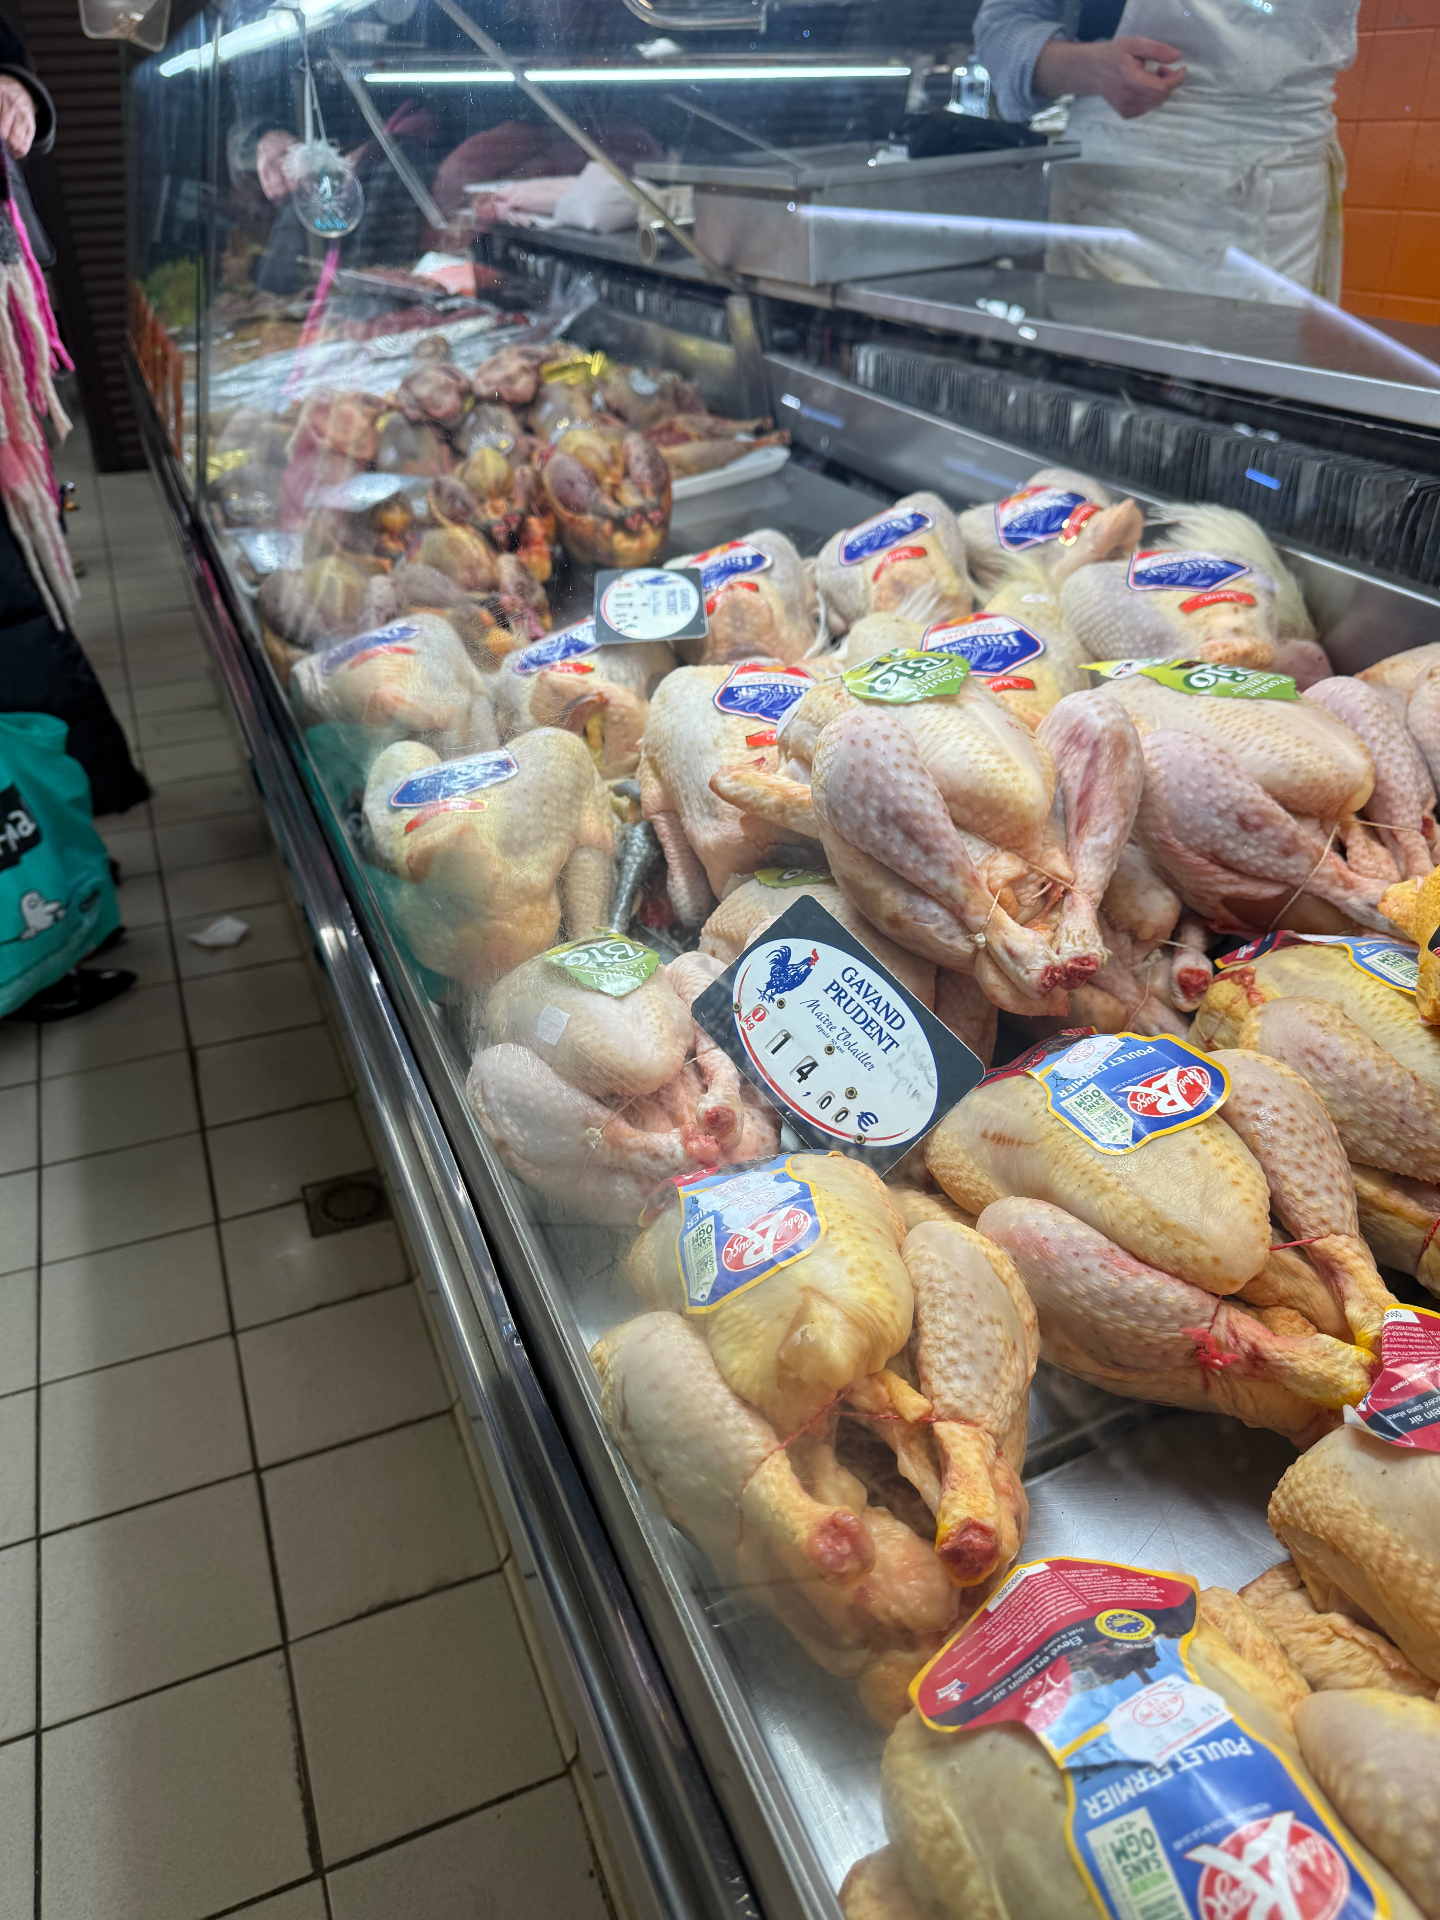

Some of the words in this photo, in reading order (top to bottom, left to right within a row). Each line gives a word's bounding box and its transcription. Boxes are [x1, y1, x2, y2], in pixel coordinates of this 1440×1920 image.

[840, 966, 907, 1031] GAVAND
[743, 1015, 756, 1031] kg
[823, 979, 900, 1055] PRUDENT
[800, 998, 838, 1034] Maître
[840, 1026, 876, 1072] Volailler
[815, 1022, 831, 1041] depuis
[1108, 1045, 1156, 1067] POULET
[1075, 1089, 1100, 1107] OGM
[1083, 1096, 1106, 1112] SANS
[1099, 1111, 1124, 1128] SANS
[692, 1224, 713, 1244] OGM
[693, 1234, 712, 1252] SANS
[724, 1203, 796, 1266] Rouge
[1390, 1379, 1408, 1392] France
[1406, 1405, 1423, 1414] sans
[1409, 1415, 1424, 1426] air
[1050, 1635, 1083, 1660] Élevé
[1035, 1655, 1047, 1669] en
[995, 1678, 1011, 1690] sans
[1009, 1665, 1034, 1690] plein
[992, 1686, 1006, 1703] air
[1173, 1736, 1255, 1773] POULET
[1082, 1763, 1174, 1820] FERMIER
[1110, 1830, 1156, 1865] OGM
[1120, 1852, 1162, 1883] SANS
